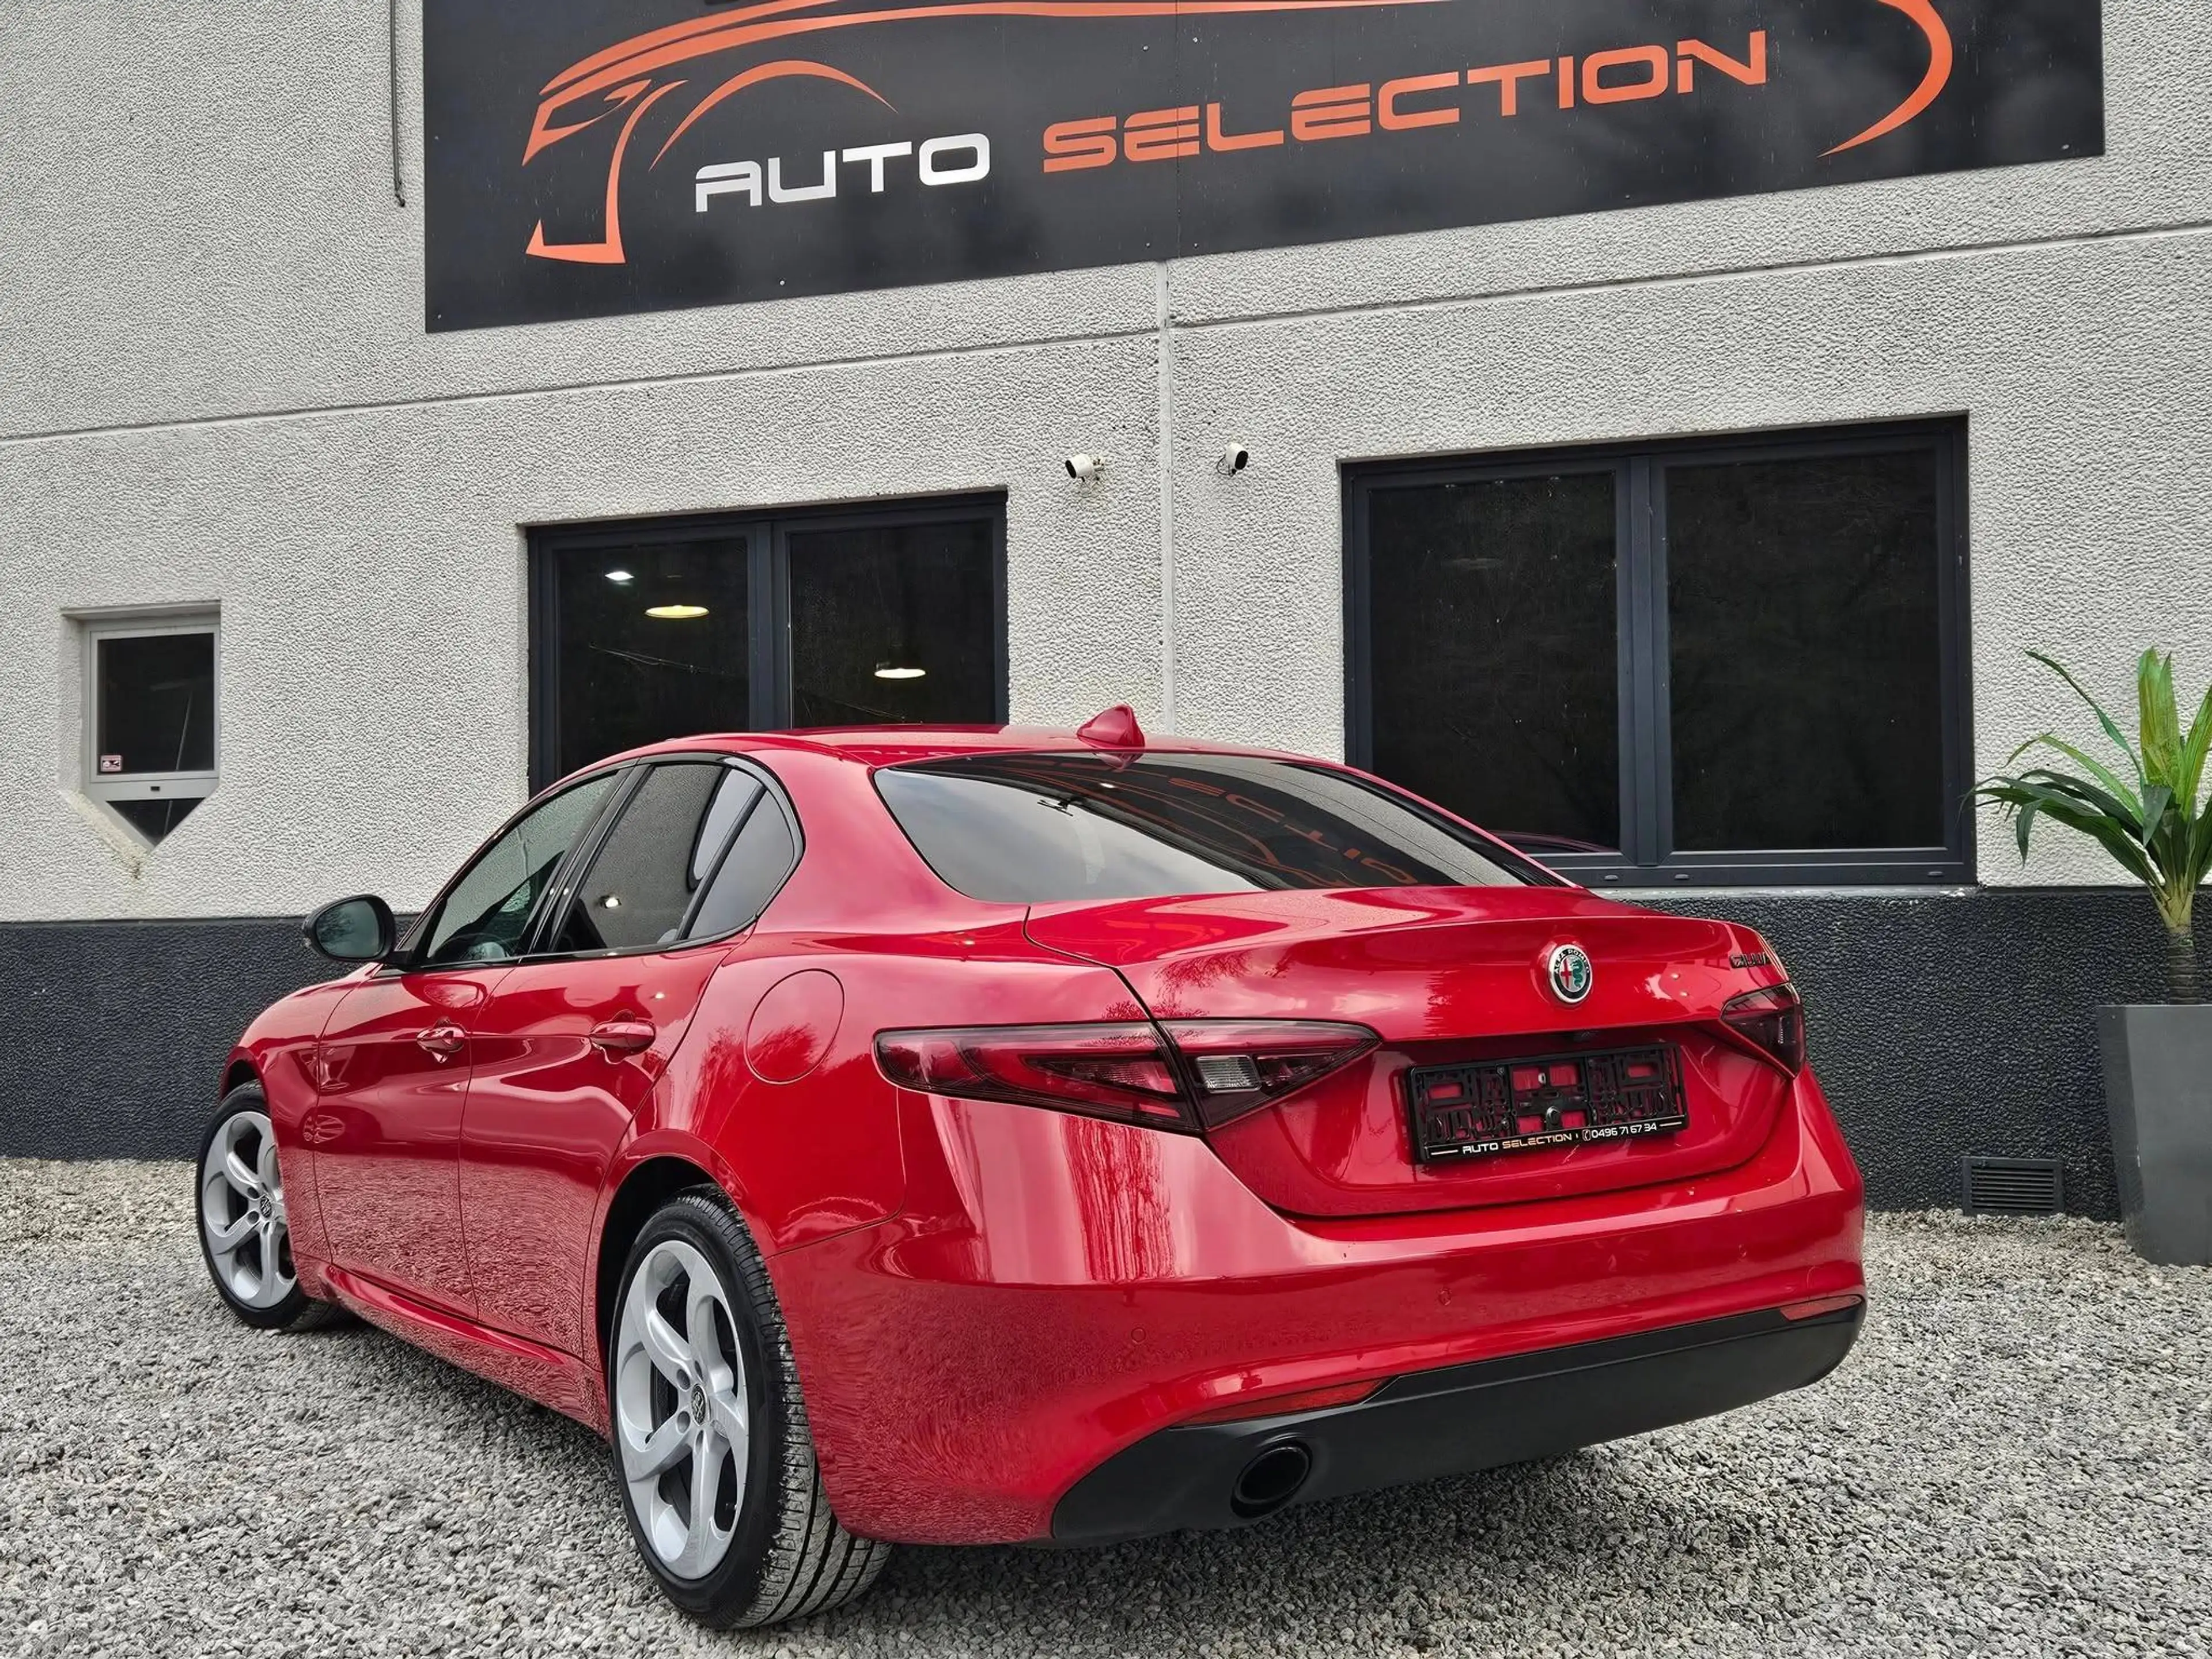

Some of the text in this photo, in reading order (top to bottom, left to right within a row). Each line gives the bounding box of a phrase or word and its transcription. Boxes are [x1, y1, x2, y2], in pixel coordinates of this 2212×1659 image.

[696, 32, 1766, 212] AUTO SELECTION
[1462, 1122, 1657, 1154] AUTO SELECTION 0496 71 67 34
